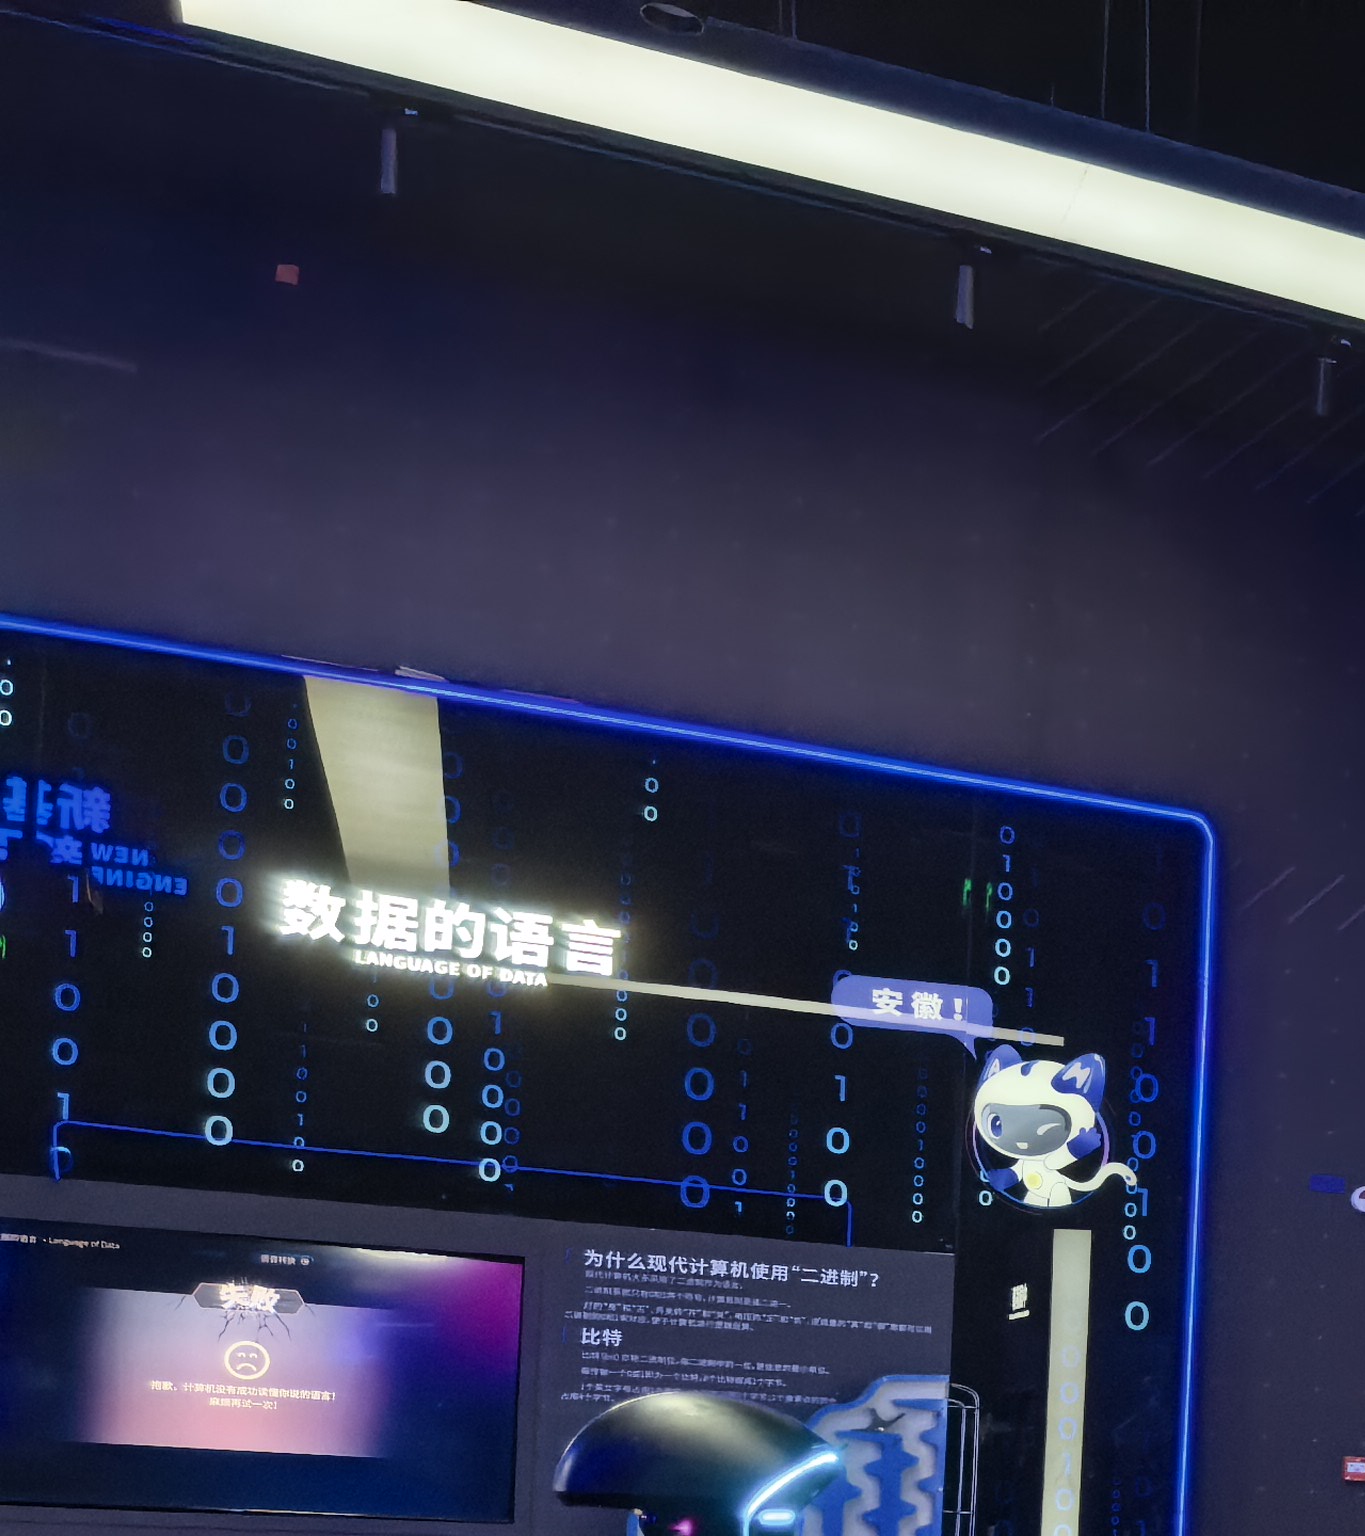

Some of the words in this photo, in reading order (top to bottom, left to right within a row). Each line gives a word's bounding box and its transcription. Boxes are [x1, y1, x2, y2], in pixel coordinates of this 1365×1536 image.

[279, 878, 623, 978] 数据的语言
[353, 949, 460, 978] LANGUAGE
[465, 962, 494, 982] OF
[498, 967, 548, 988] DATA
[580, 1327, 624, 1348] 比特
